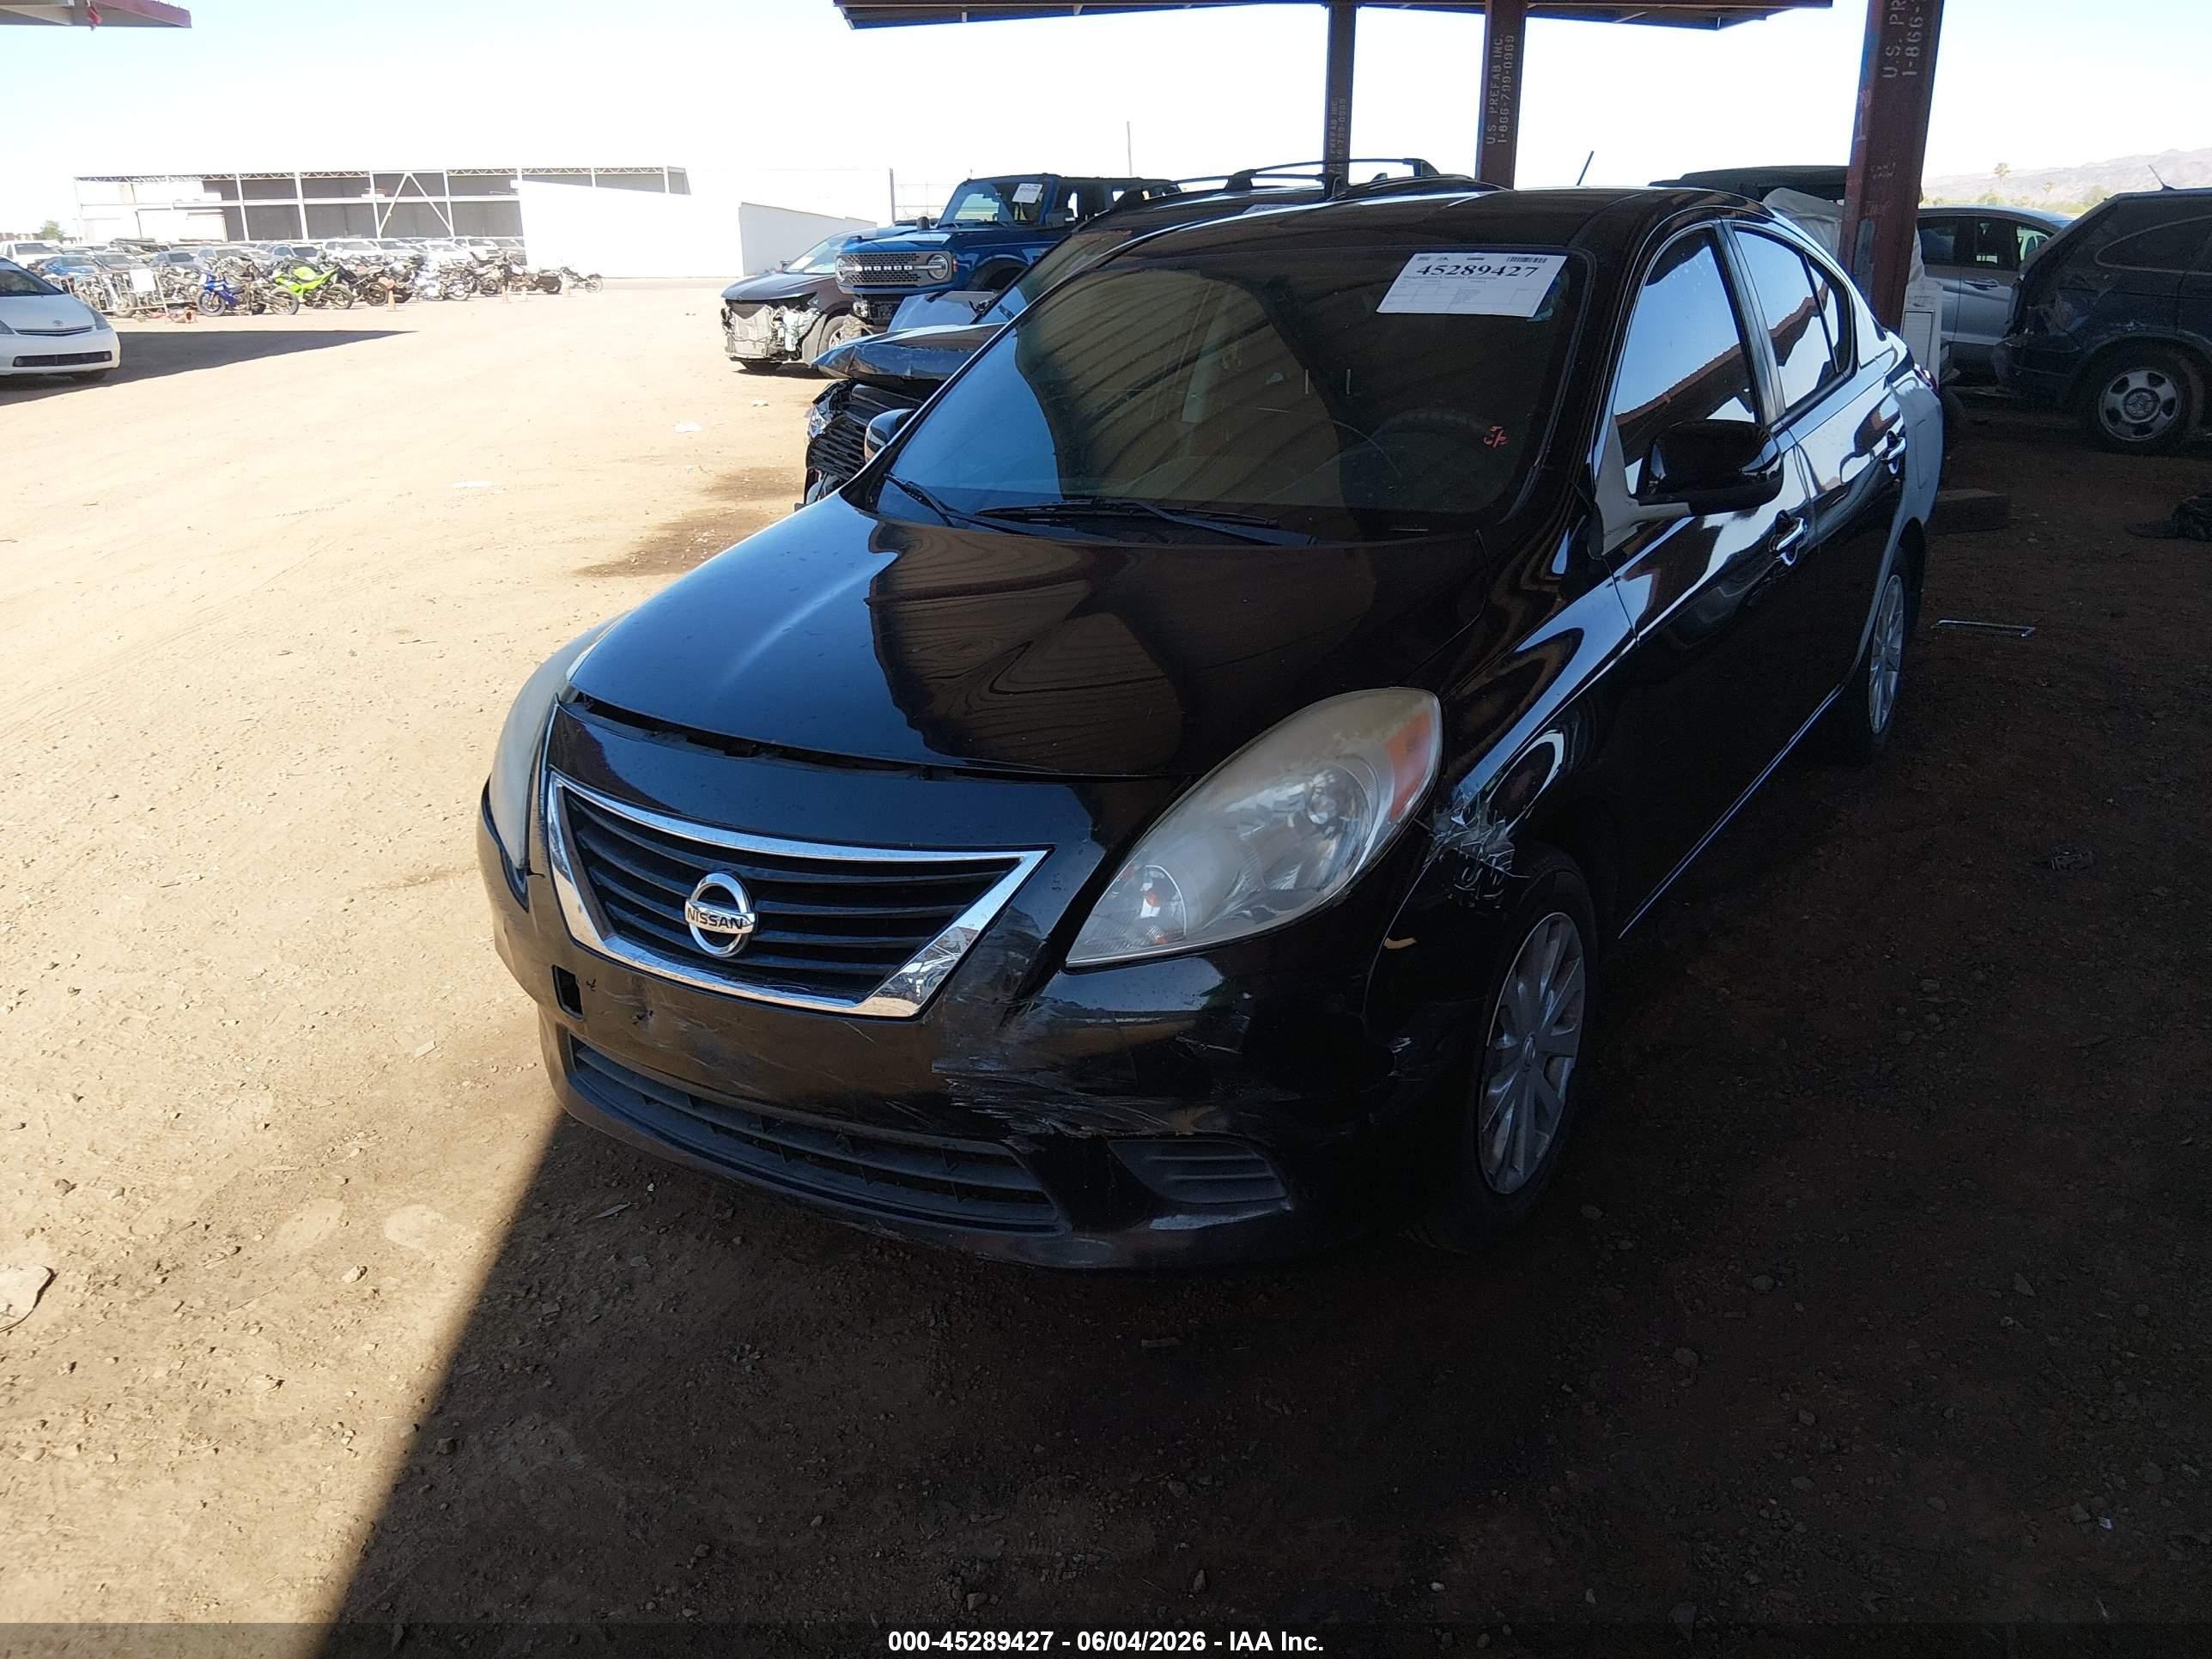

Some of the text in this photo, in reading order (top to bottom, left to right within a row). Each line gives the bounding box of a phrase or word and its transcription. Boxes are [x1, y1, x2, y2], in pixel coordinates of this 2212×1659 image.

[1901, 0, 1924, 76] 1-866-
[1882, 39, 1902, 78] U.S.
[1488, 65, 1502, 114] PREFAB
[1416, 264, 1540, 277] 45289427
[687, 907, 744, 930] NISSAN
